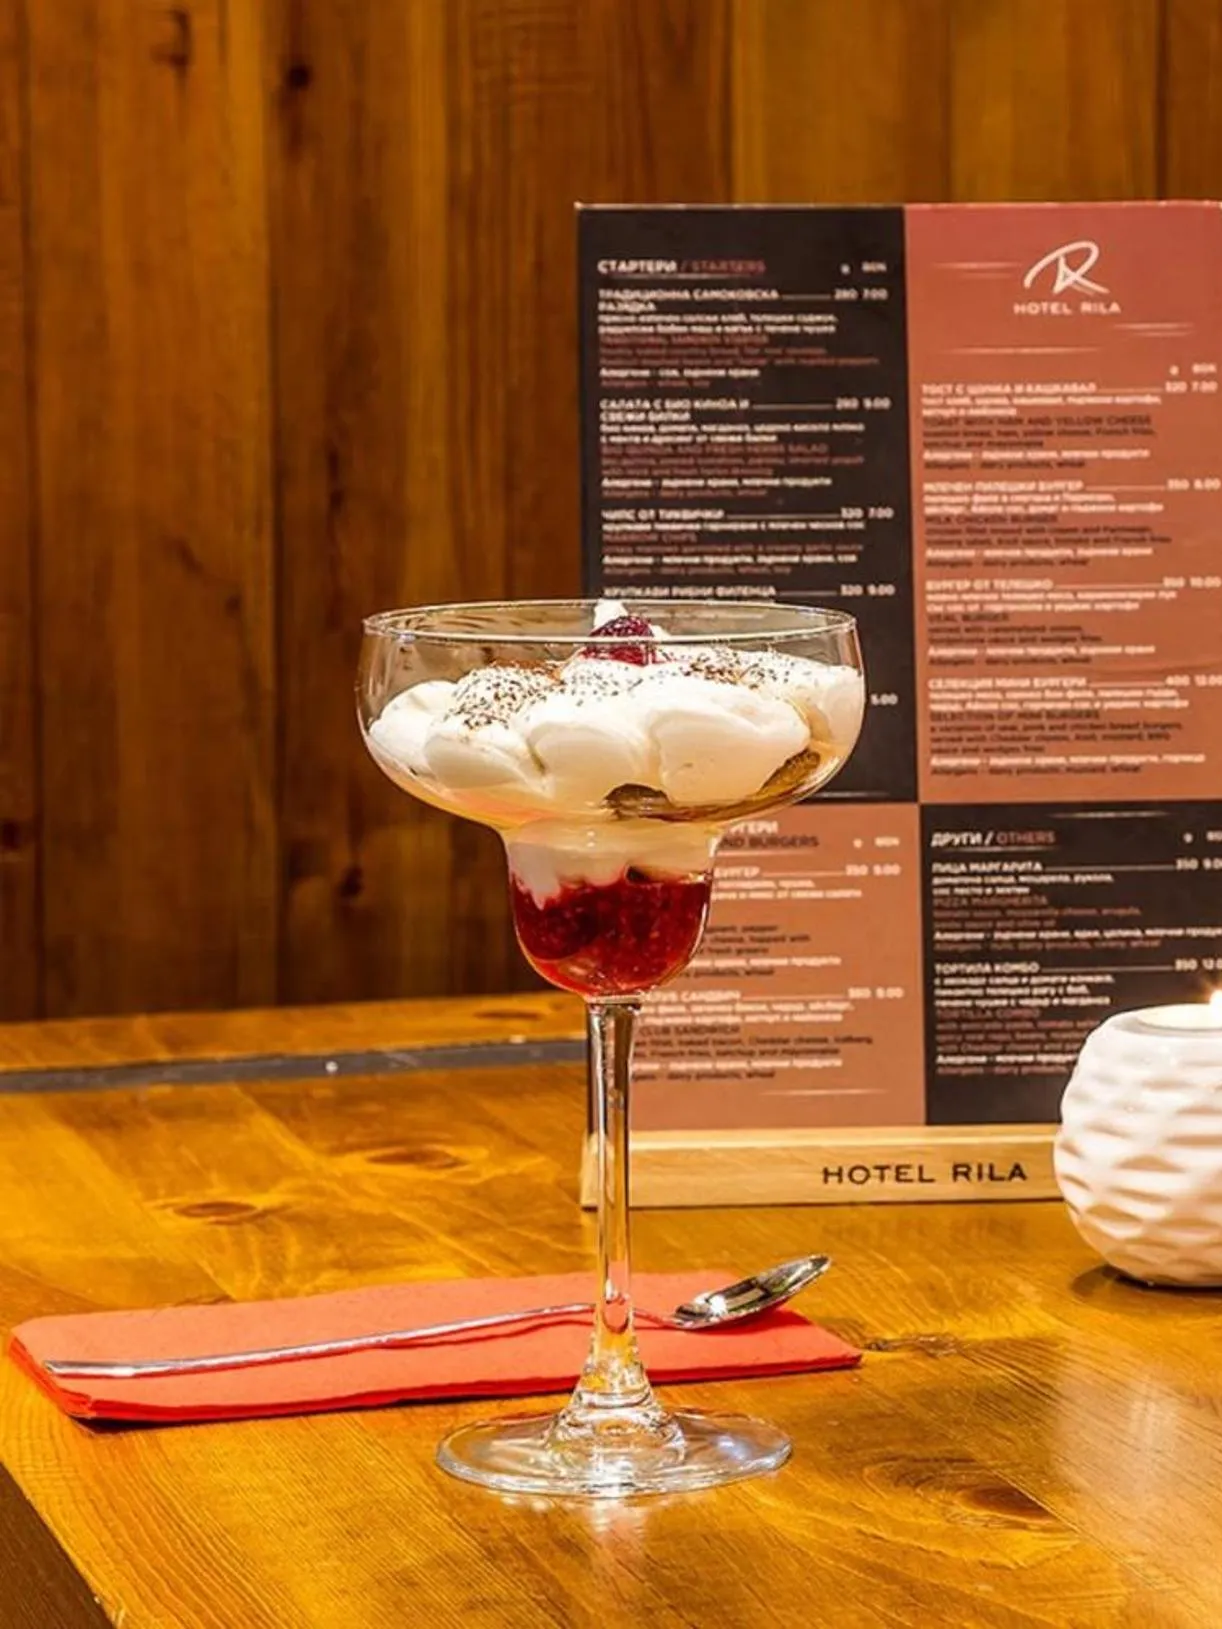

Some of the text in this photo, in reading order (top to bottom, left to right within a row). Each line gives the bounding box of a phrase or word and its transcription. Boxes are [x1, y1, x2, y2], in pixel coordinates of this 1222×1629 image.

[597, 259, 678, 273] СТАРТЕРИ
[1013, 302, 1122, 316] HOTEL RILA
[921, 383, 953, 395] ТОСТ
[599, 398, 651, 410] САЛАТА
[750, 836, 819, 849] BURGERS
[931, 832, 983, 847] ДРУГИ
[996, 831, 1057, 845] OTHERS
[932, 863, 967, 874] ПИЦА
[969, 862, 1043, 873] МАРГАРИТА
[934, 963, 992, 974] ТОРТИЛА
[993, 962, 1039, 973] КОМБО
[822, 1162, 1028, 1185] HOTEL RILA
